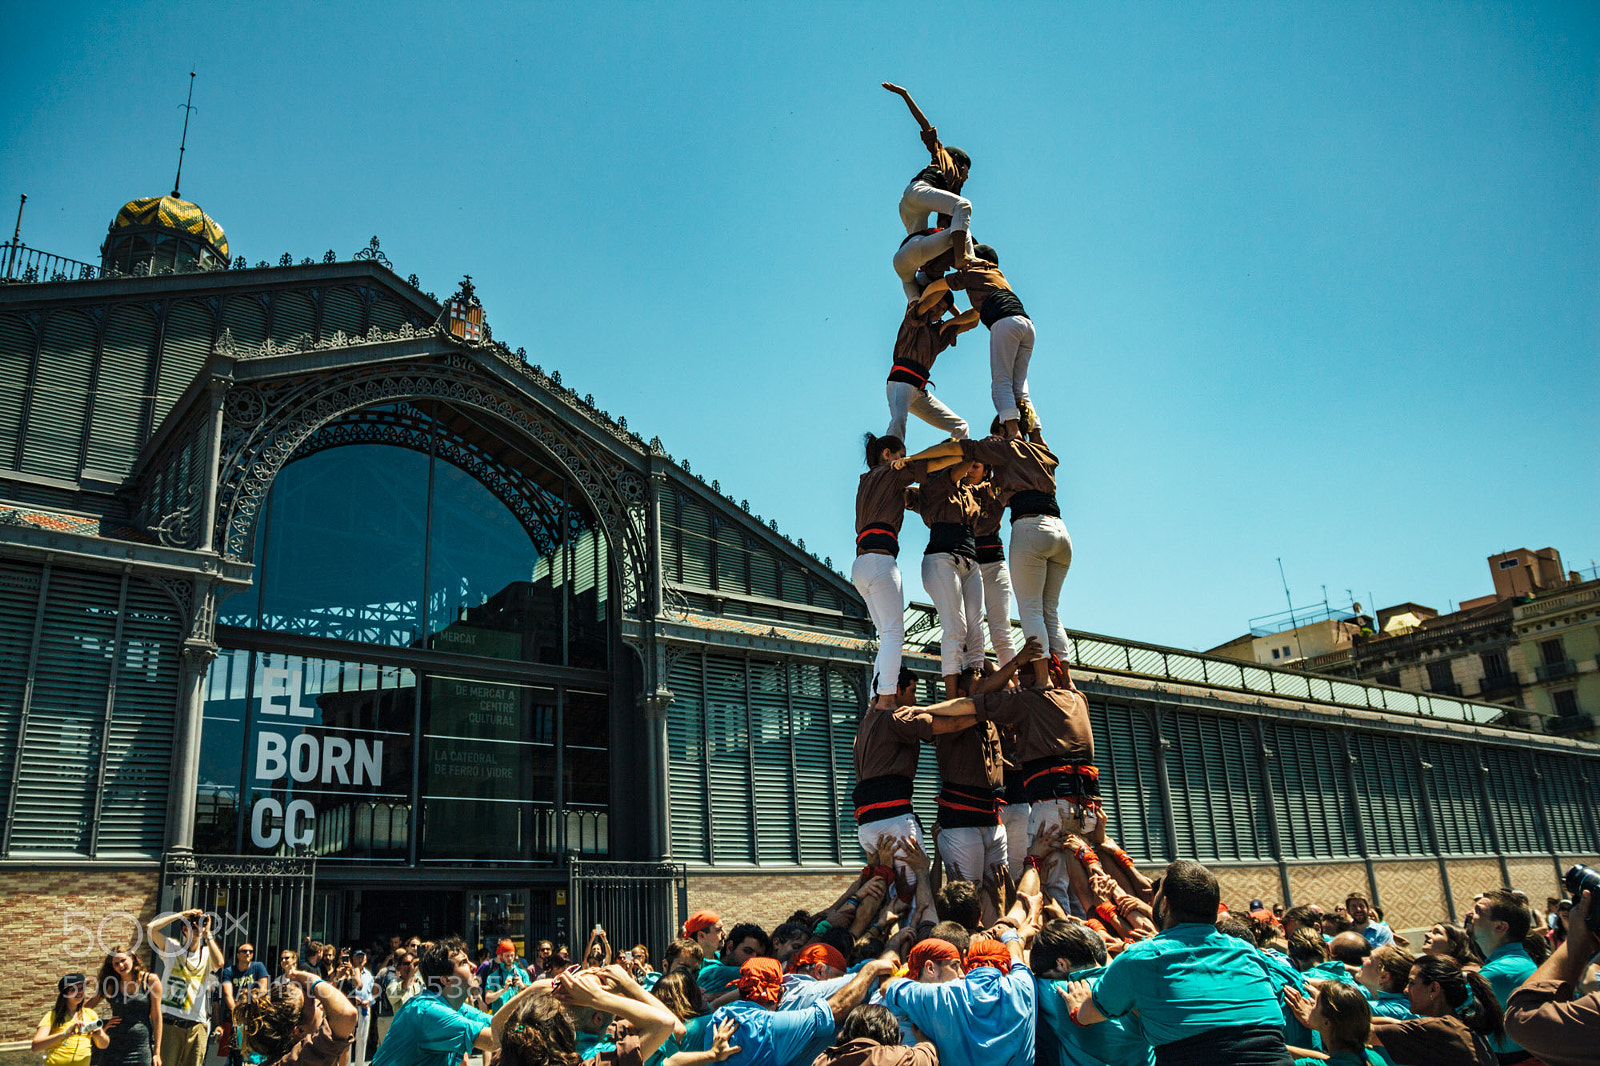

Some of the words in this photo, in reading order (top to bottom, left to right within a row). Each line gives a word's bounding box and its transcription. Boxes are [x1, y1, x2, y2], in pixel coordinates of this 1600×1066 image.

[444, 354, 476, 373] 1876
[440, 631, 477, 645] MERCAT
[260, 666, 315, 718] EL
[455, 684, 468, 696] DE
[469, 686, 506, 700] MERCAT
[508, 690, 515, 700] A
[480, 700, 514, 713] CENTRE
[468, 712, 515, 727] CULTURAL
[255, 731, 383, 786] BORN
[434, 750, 448, 761] LA
[450, 751, 497, 765] CATEDRAL
[434, 763, 447, 775] DE
[448, 764, 480, 777] FERRO
[486, 767, 513, 779] VIDRE
[251, 797, 315, 849] CC
